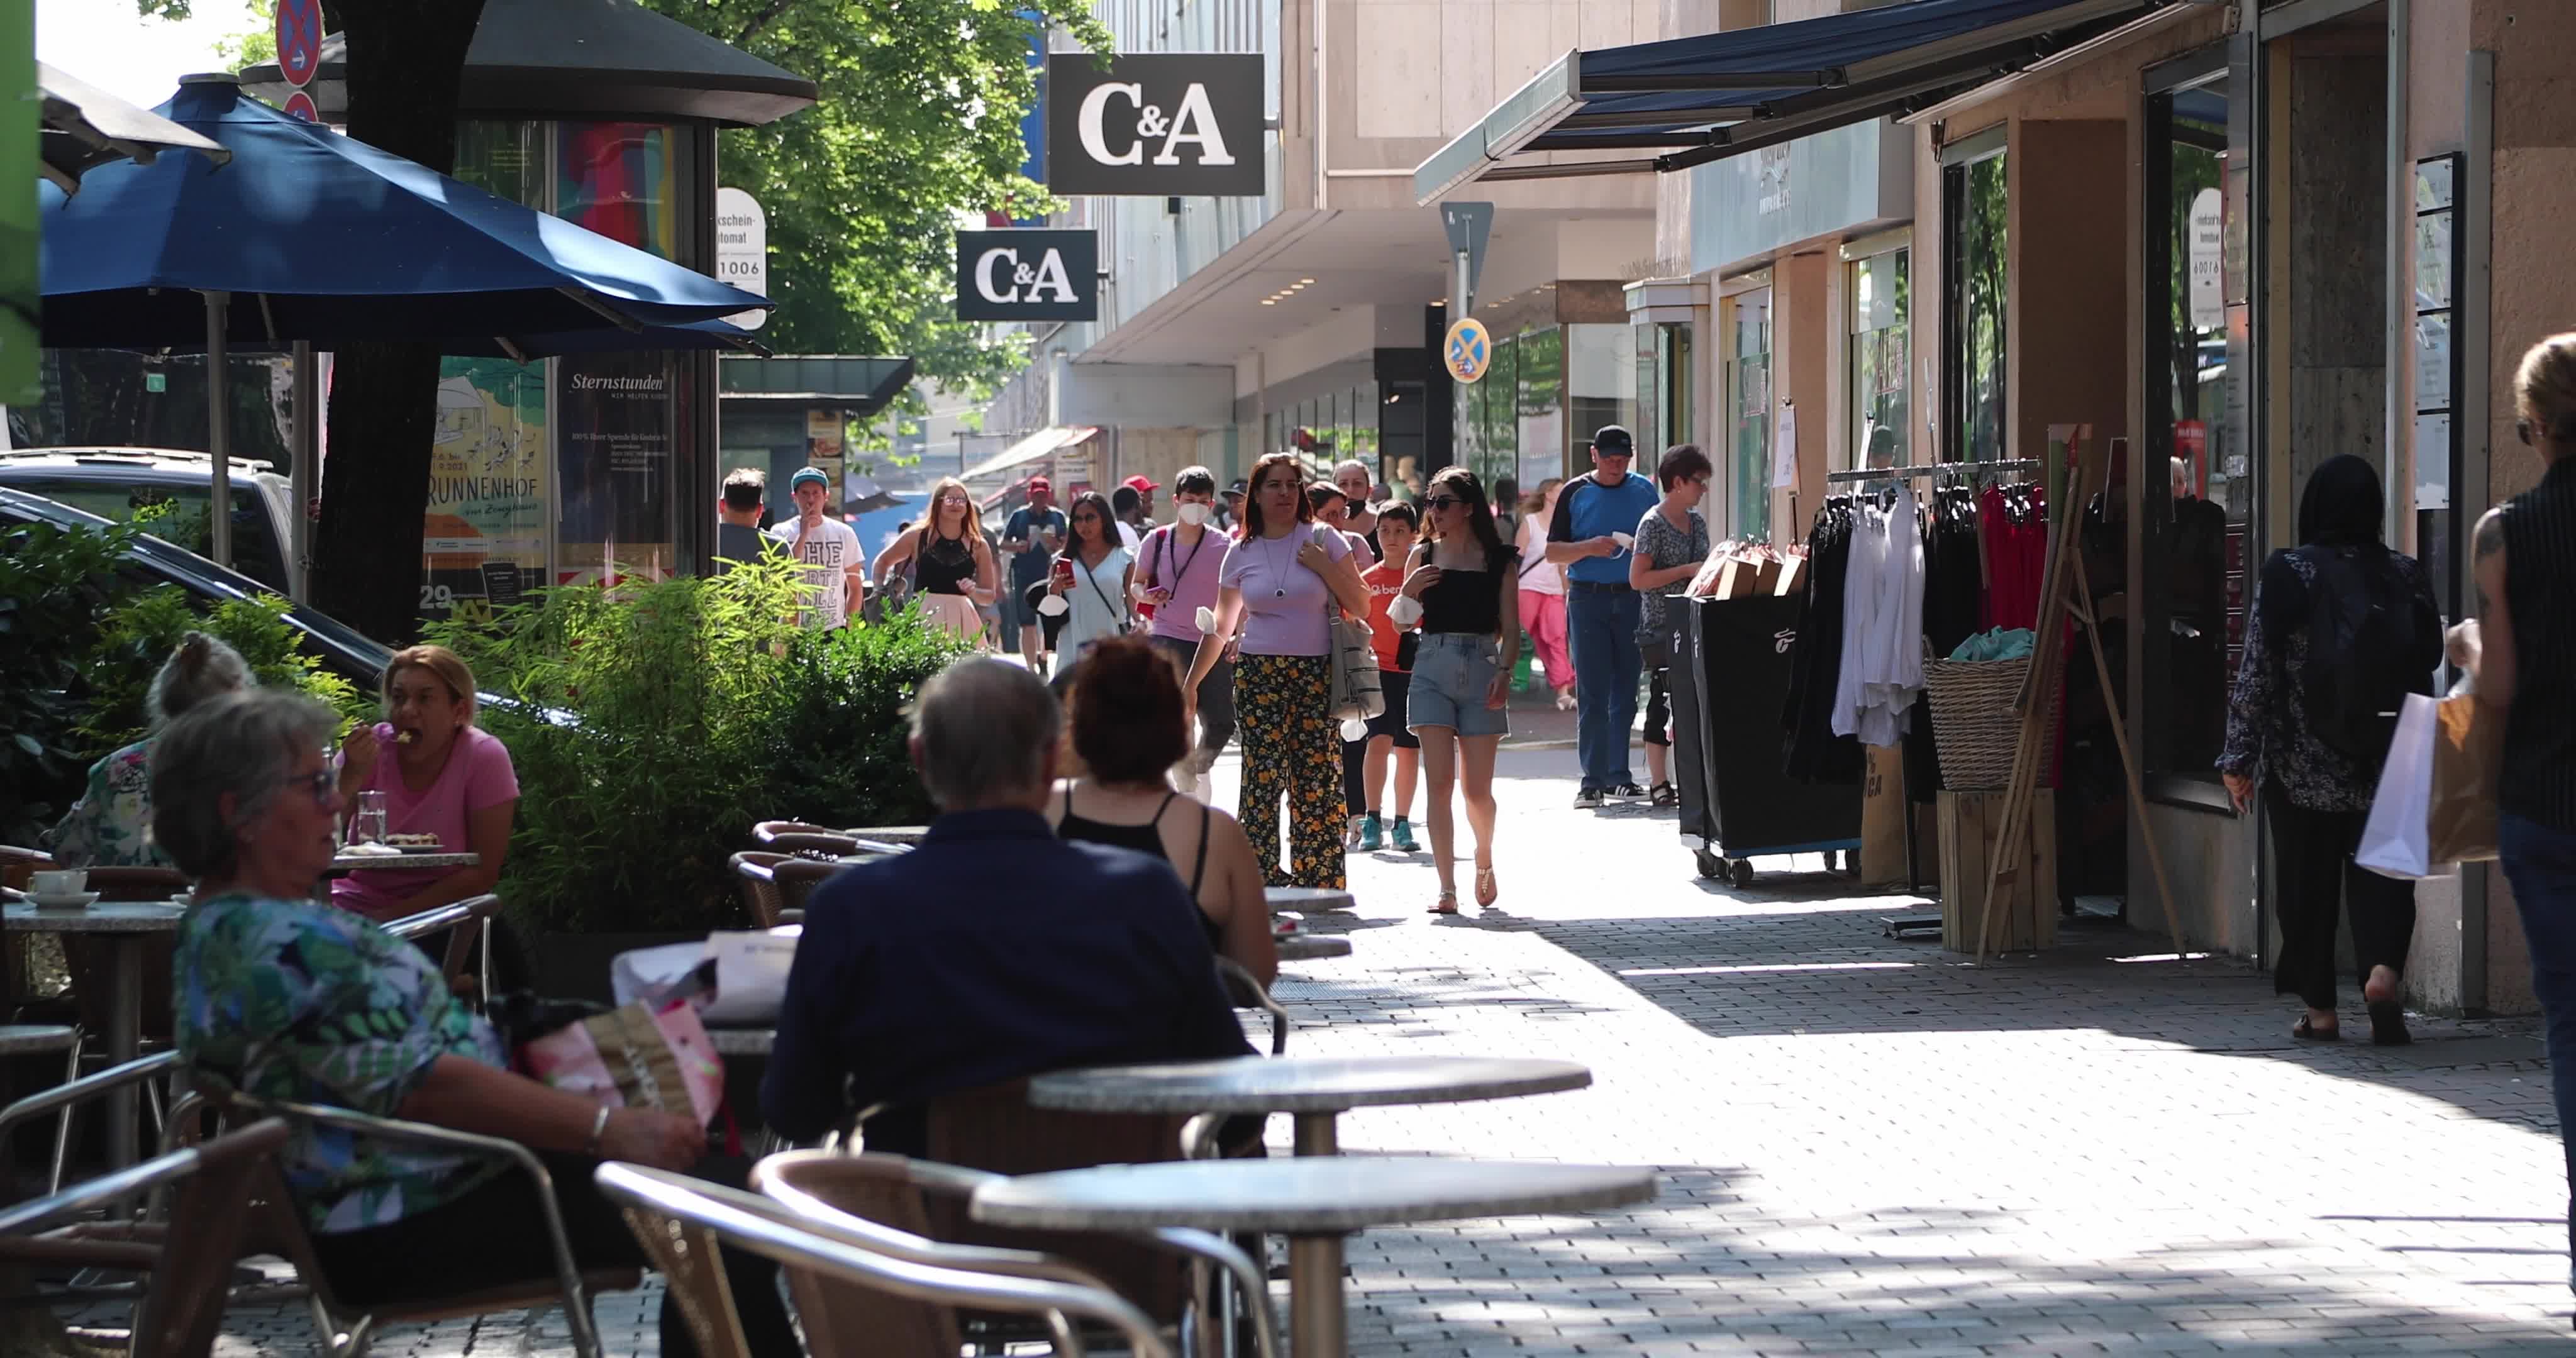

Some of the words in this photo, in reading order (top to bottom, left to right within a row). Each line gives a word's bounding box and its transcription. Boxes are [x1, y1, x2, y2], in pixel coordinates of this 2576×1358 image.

[1077, 82, 1236, 166] C&A
[974, 247, 1079, 304] C&A
[572, 373, 663, 390] Sternstunden
